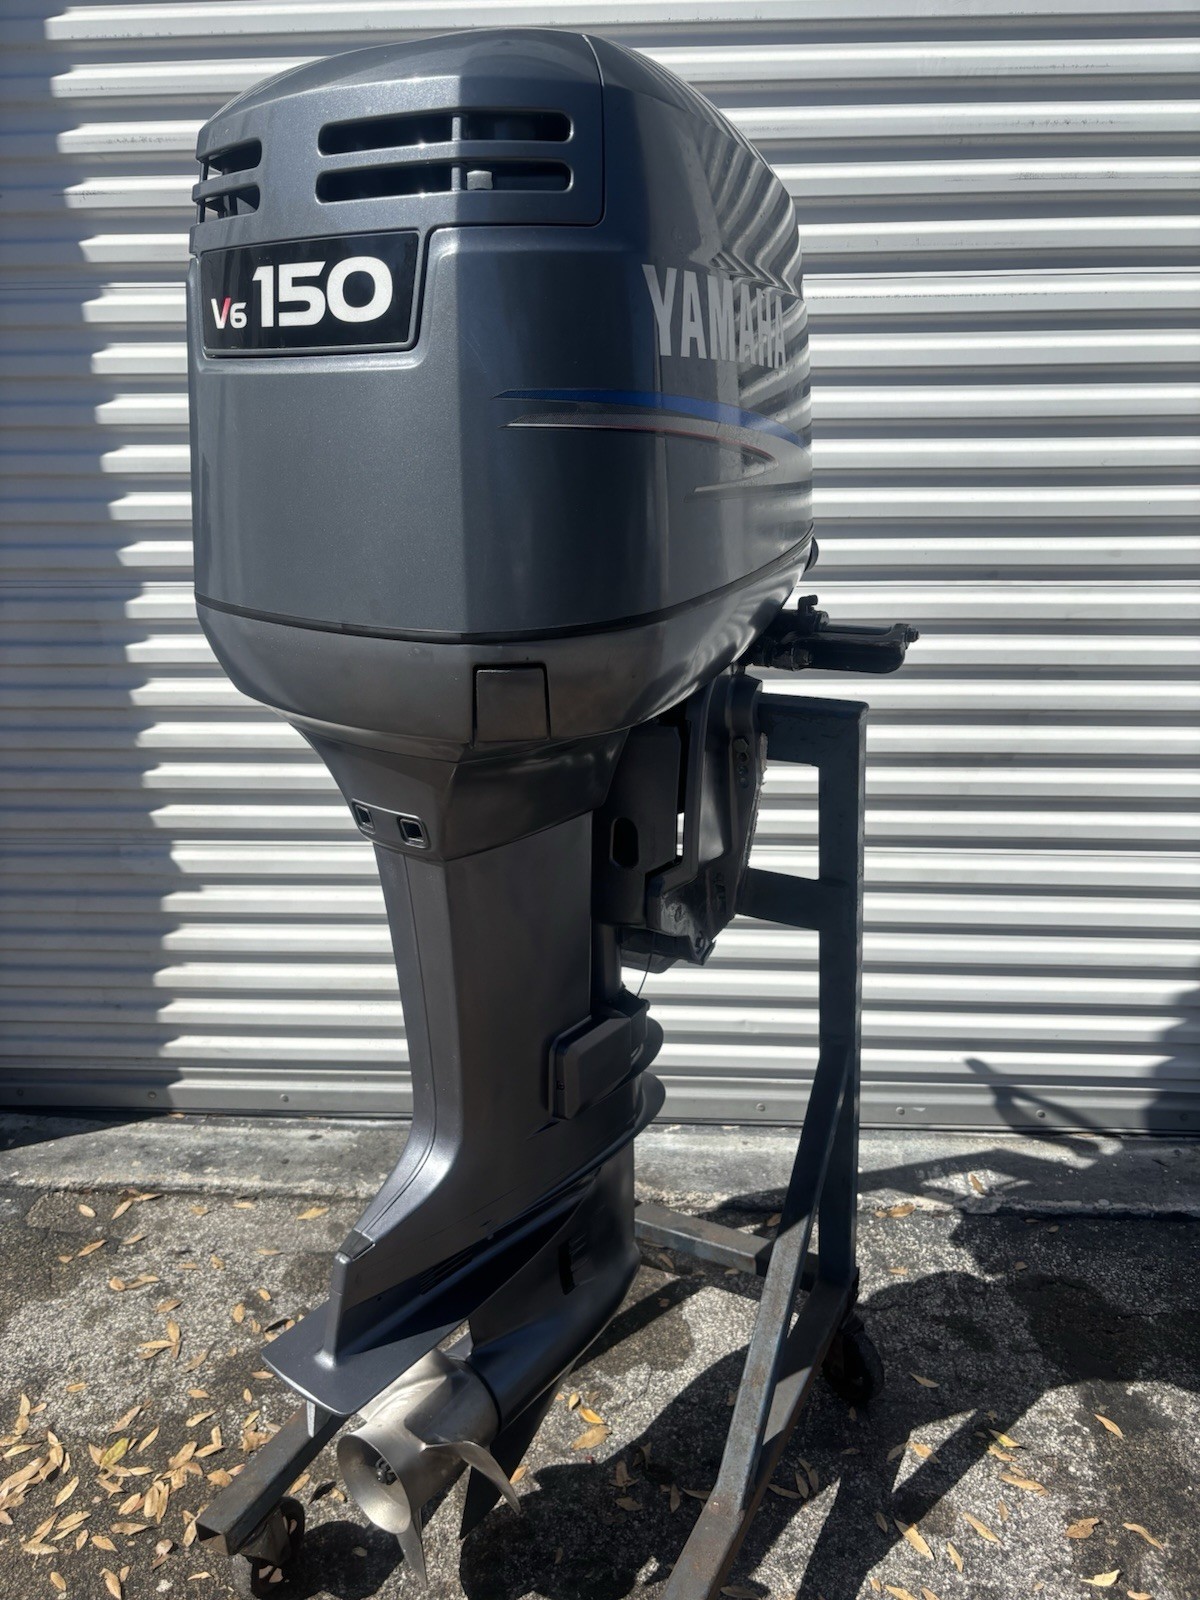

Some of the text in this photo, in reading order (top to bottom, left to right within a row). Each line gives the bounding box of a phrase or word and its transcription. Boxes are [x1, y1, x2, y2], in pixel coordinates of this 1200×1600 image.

[211, 256, 393, 329] V6 150
[641, 263, 787, 370] YAMAHA
